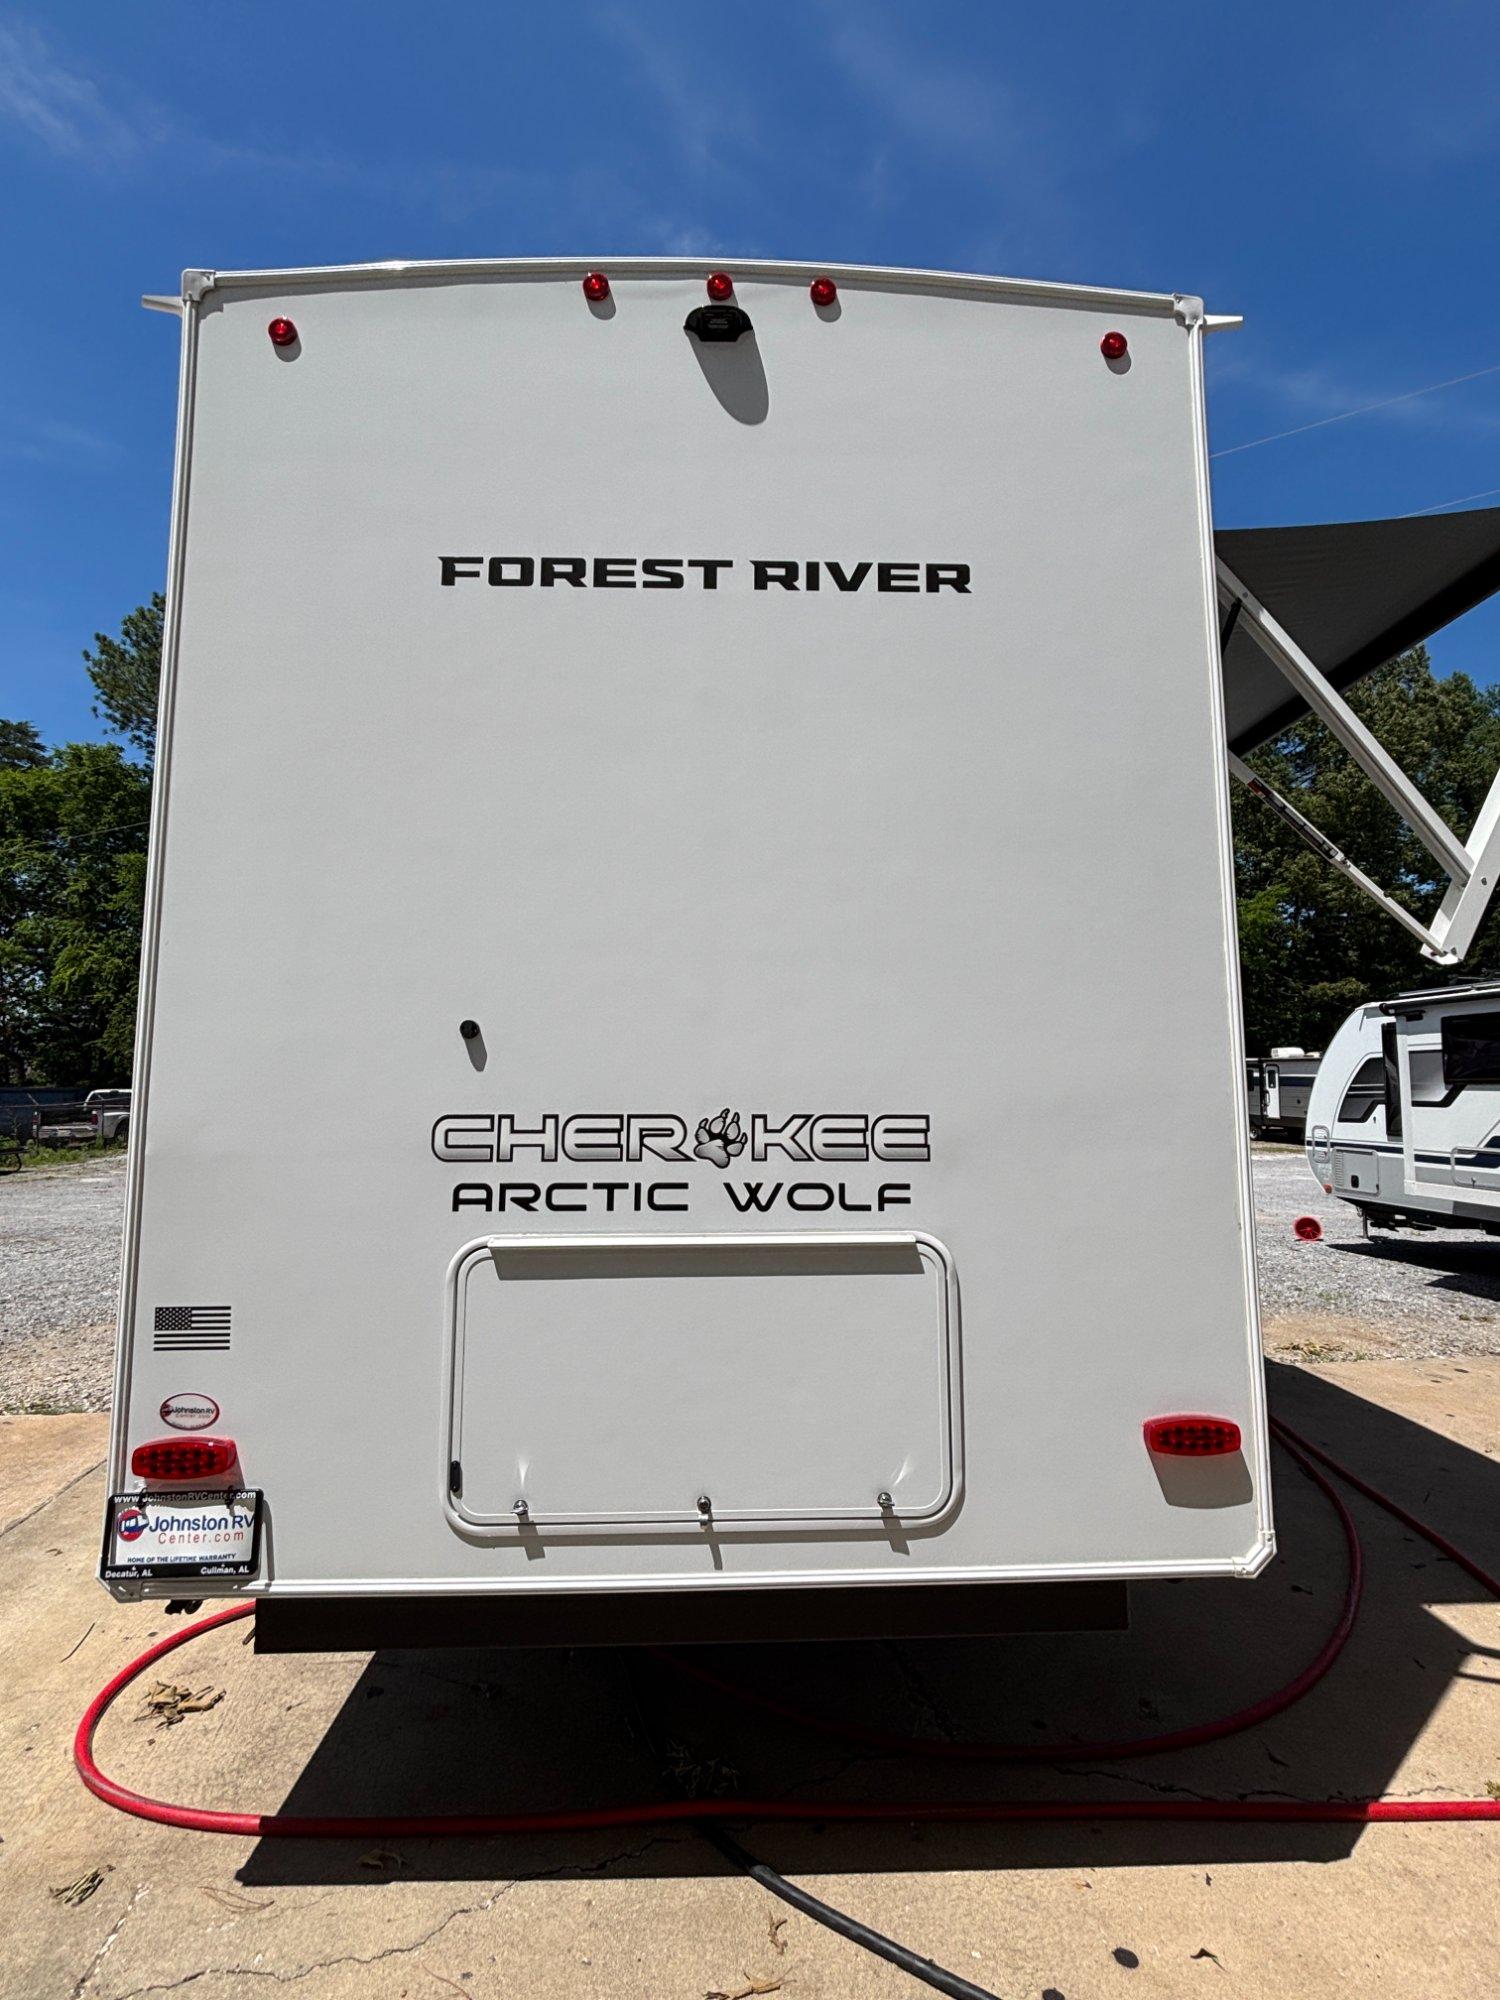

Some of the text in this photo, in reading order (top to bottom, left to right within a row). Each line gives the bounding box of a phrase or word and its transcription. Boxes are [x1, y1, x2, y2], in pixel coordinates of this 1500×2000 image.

[438, 556, 972, 593] FOREST RIVER
[431, 1112, 931, 1164] CHERKEE
[452, 1182, 911, 1212] ARCTIC WOLF
[114, 1491, 256, 1504] wwwJohnstonRVCentr.com
[150, 1515, 255, 1532] Johnston RV
[158, 1531, 244, 1545] Center.com
[199, 1553, 236, 1561] WARRANTY
[105, 1569, 153, 1579] Decatur, AL
[200, 1565, 249, 1575] Cullman, AL
